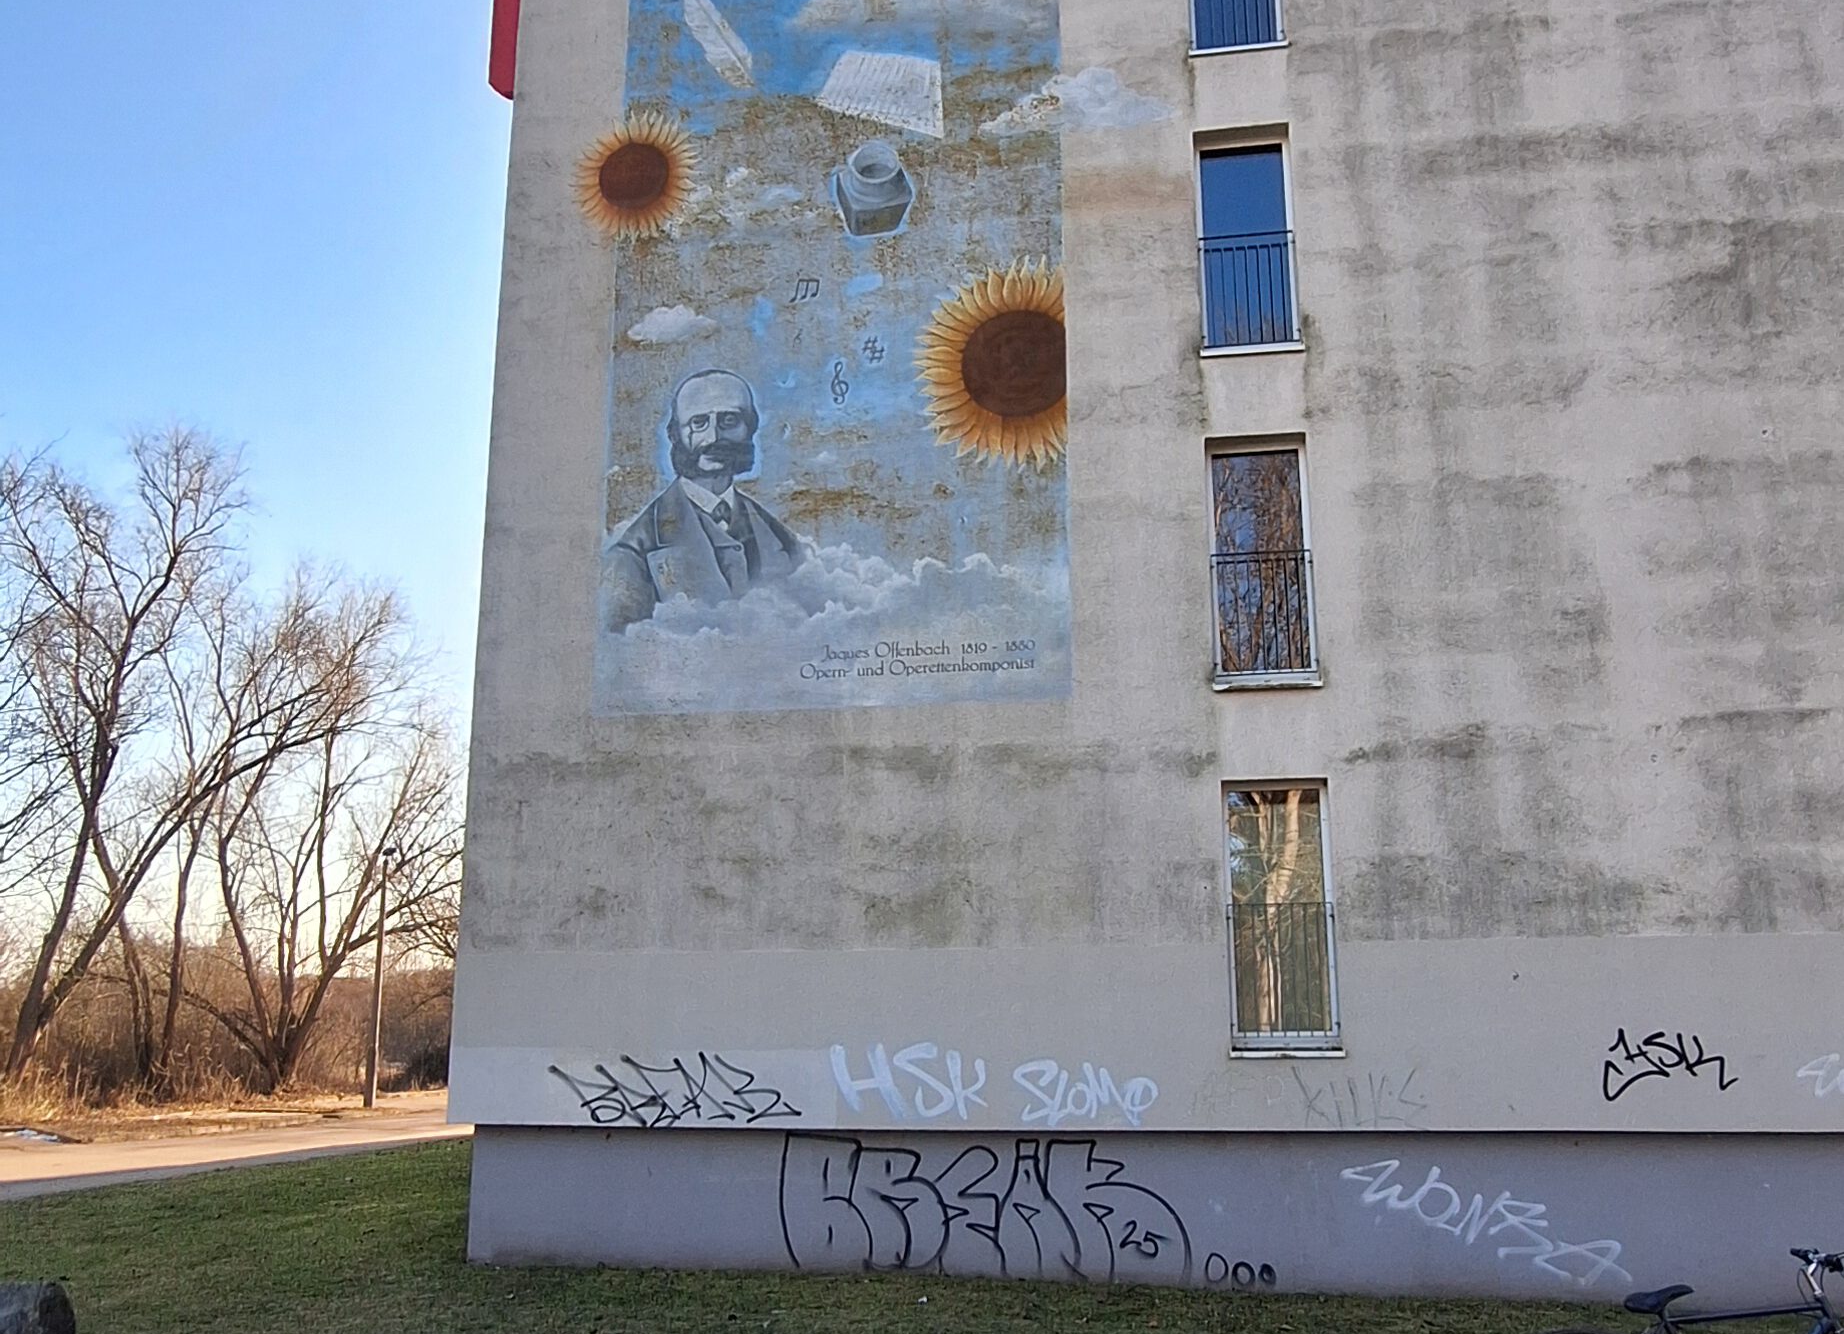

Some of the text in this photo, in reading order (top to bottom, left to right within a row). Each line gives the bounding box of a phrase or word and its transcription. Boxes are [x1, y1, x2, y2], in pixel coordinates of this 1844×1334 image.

[820, 643, 870, 663] Jaques
[874, 640, 951, 660] Offenbach
[961, 641, 988, 656] 1819
[856, 660, 885, 677] und
[888, 656, 1036, 678] Operettenkomponist
[829, 1041, 989, 1121] HSK
[1118, 1219, 1170, 1259] 25
